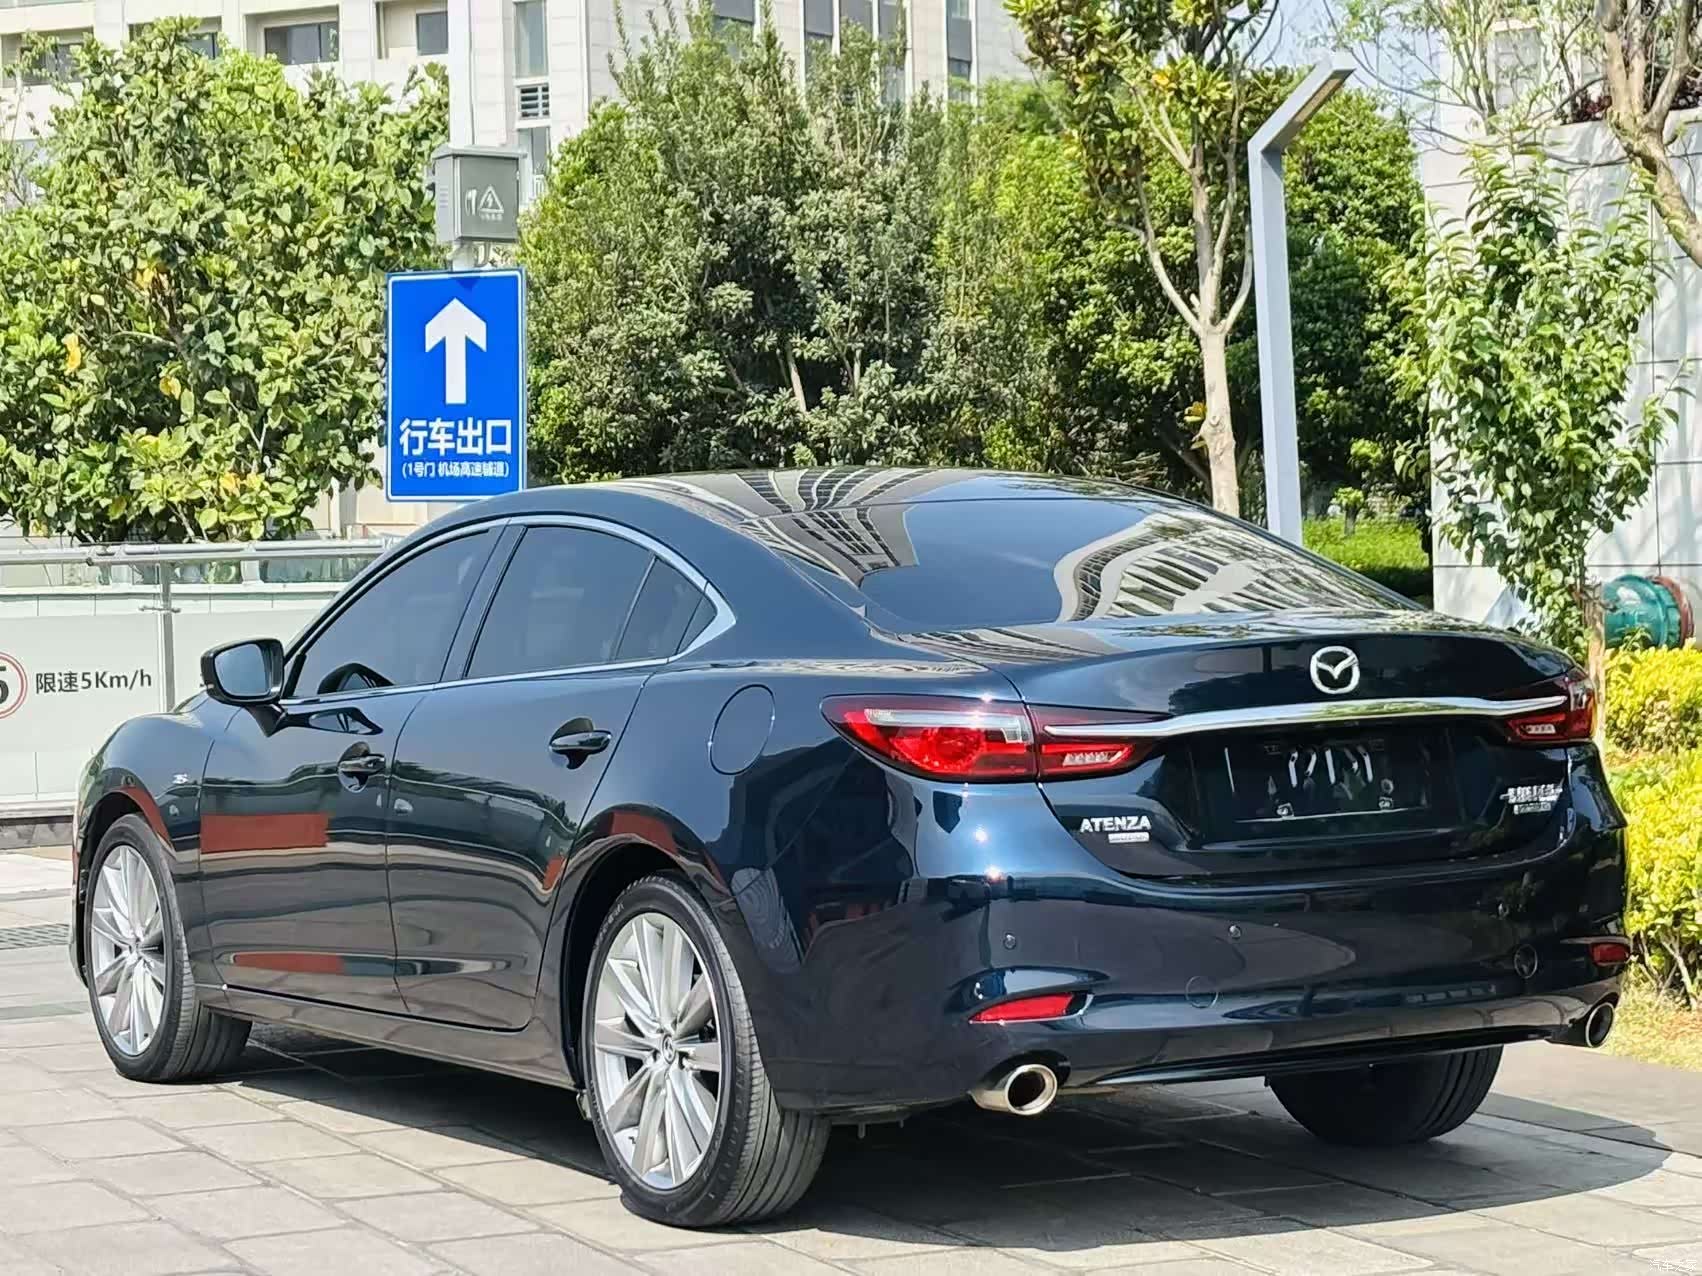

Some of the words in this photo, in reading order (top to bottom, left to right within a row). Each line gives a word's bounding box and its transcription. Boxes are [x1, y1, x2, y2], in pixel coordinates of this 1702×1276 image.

[399, 417, 512, 456] 行车出口
[35, 668, 152, 694] 限速5Km/h
[1080, 815, 1152, 833] ATENZA
